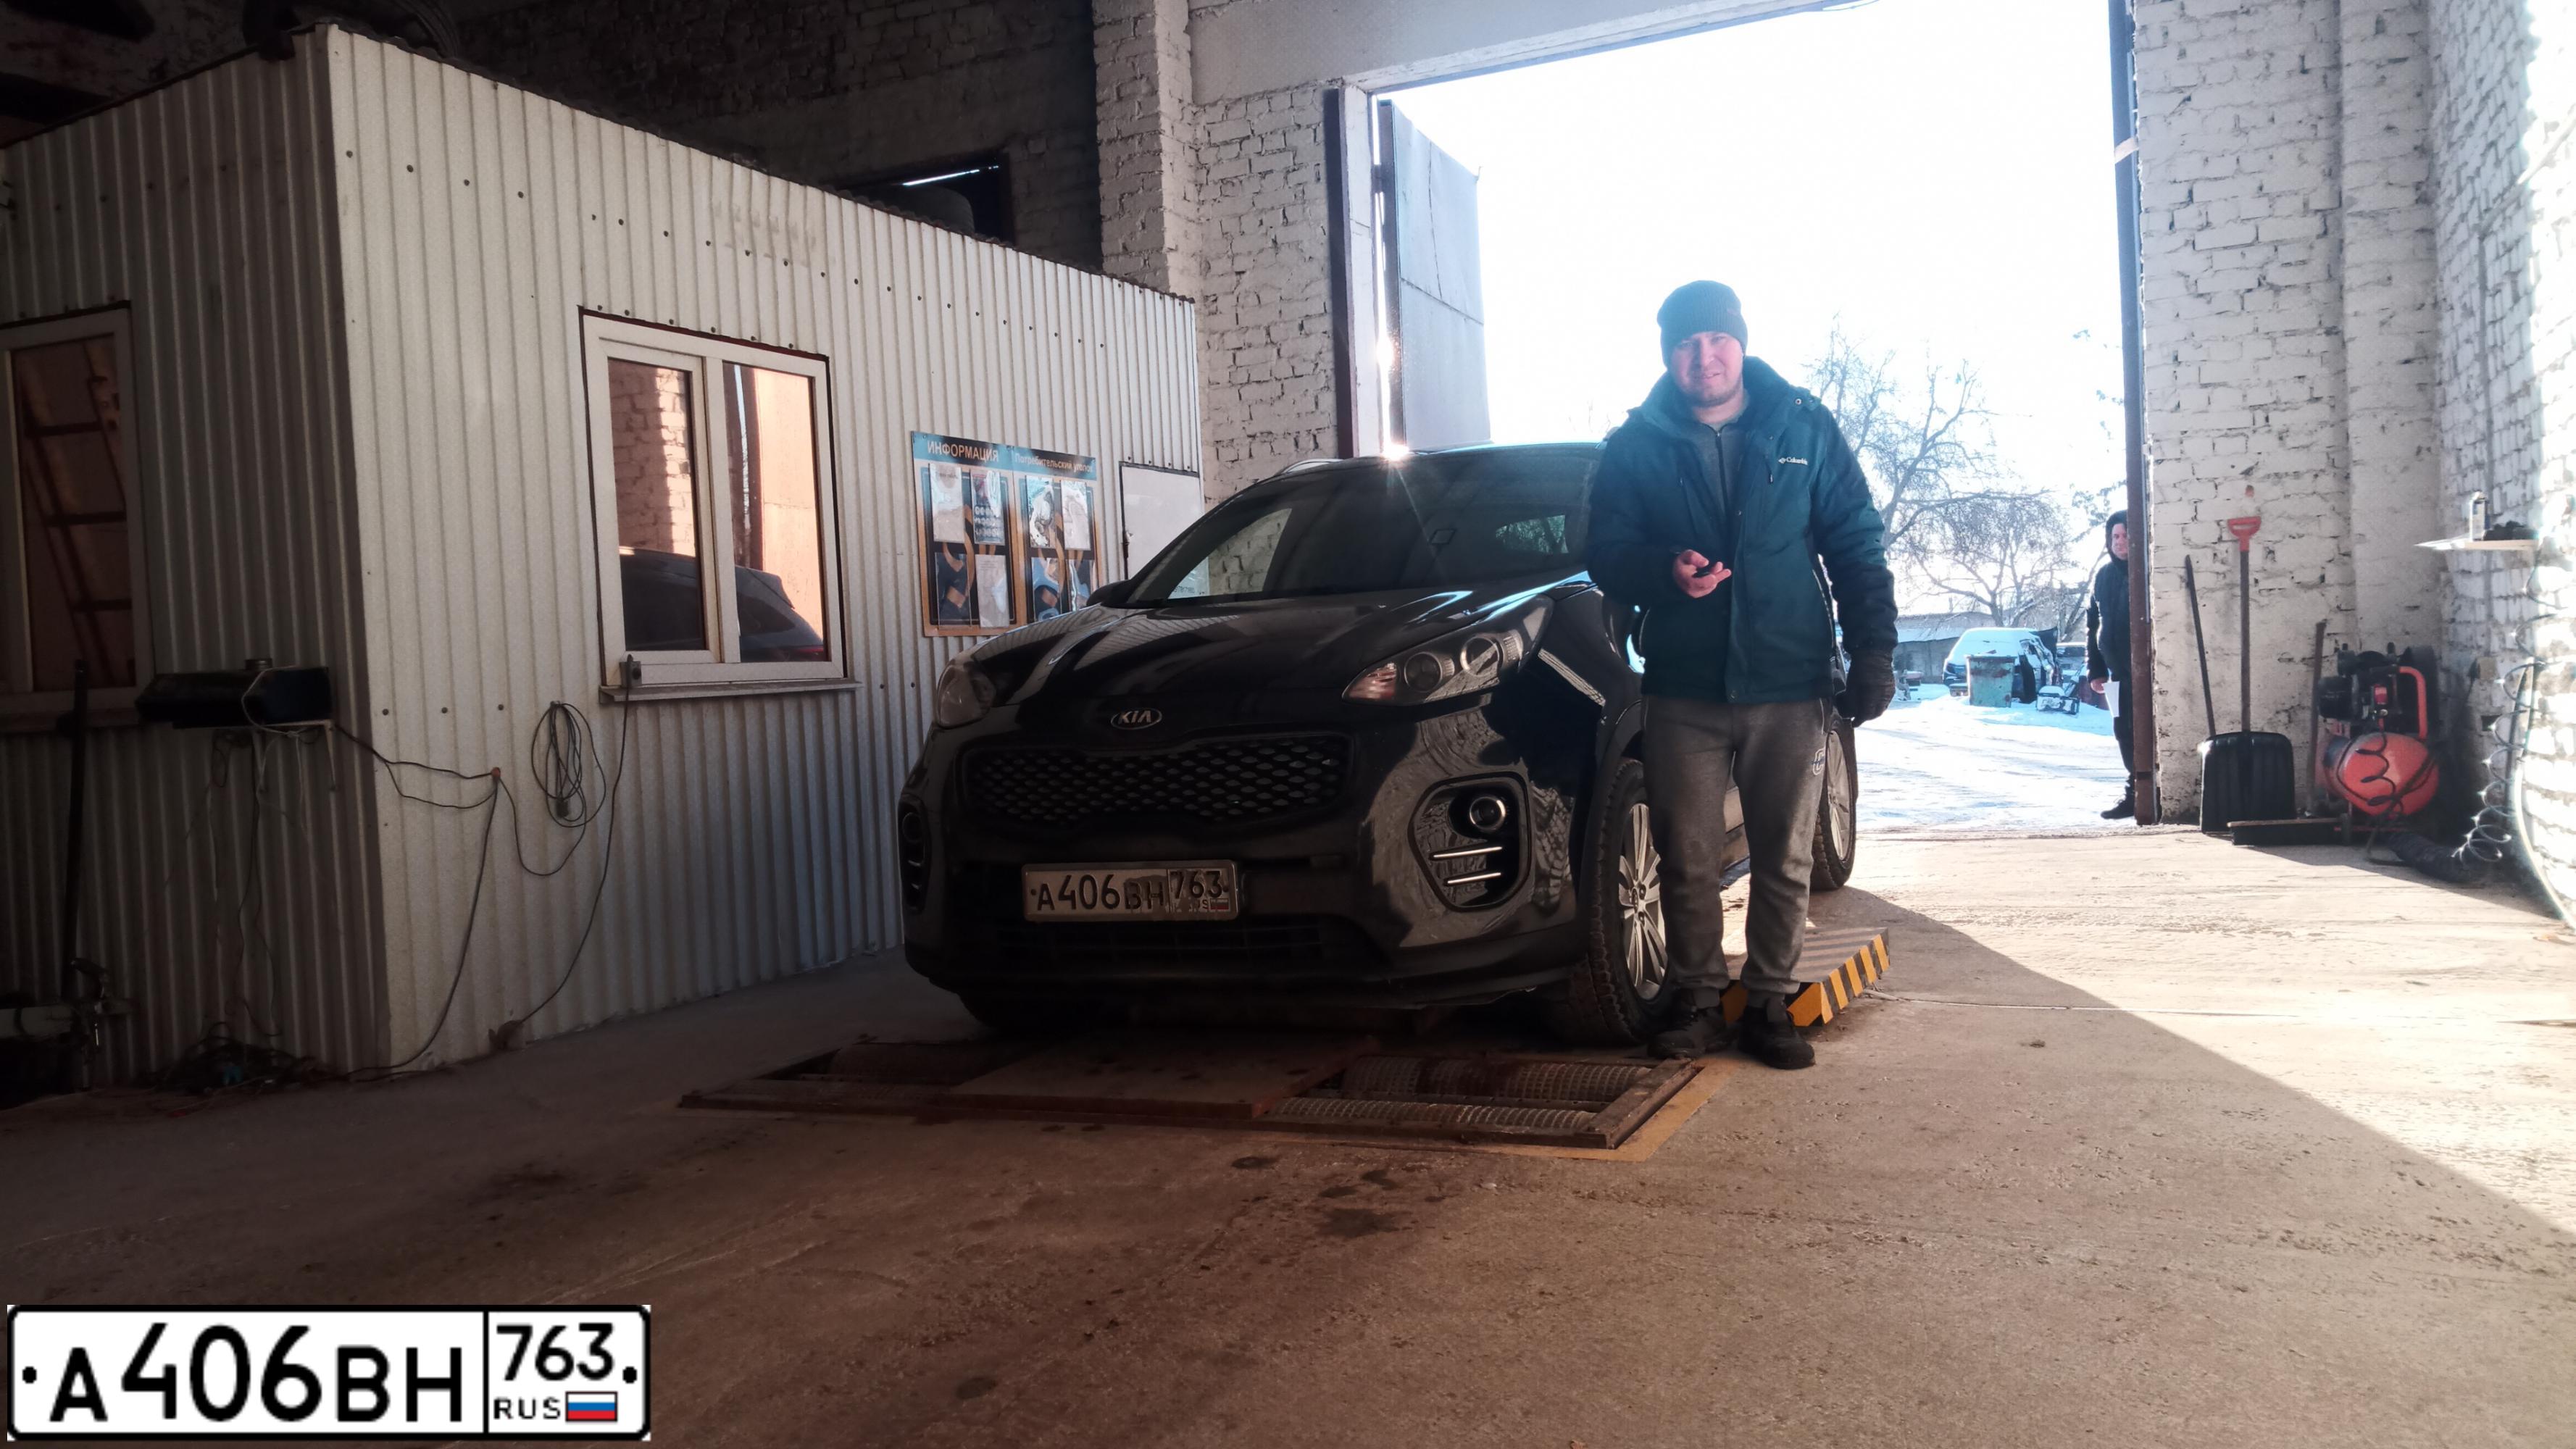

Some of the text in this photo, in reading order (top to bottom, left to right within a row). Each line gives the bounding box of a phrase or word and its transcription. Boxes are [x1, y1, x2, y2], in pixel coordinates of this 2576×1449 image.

[927, 440, 999, 462] ИНФОРМАЦИЯ
[1015, 453, 1073, 469] Потребительский
[1118, 711, 1151, 724] KIA
[1170, 870, 1222, 899] 763
